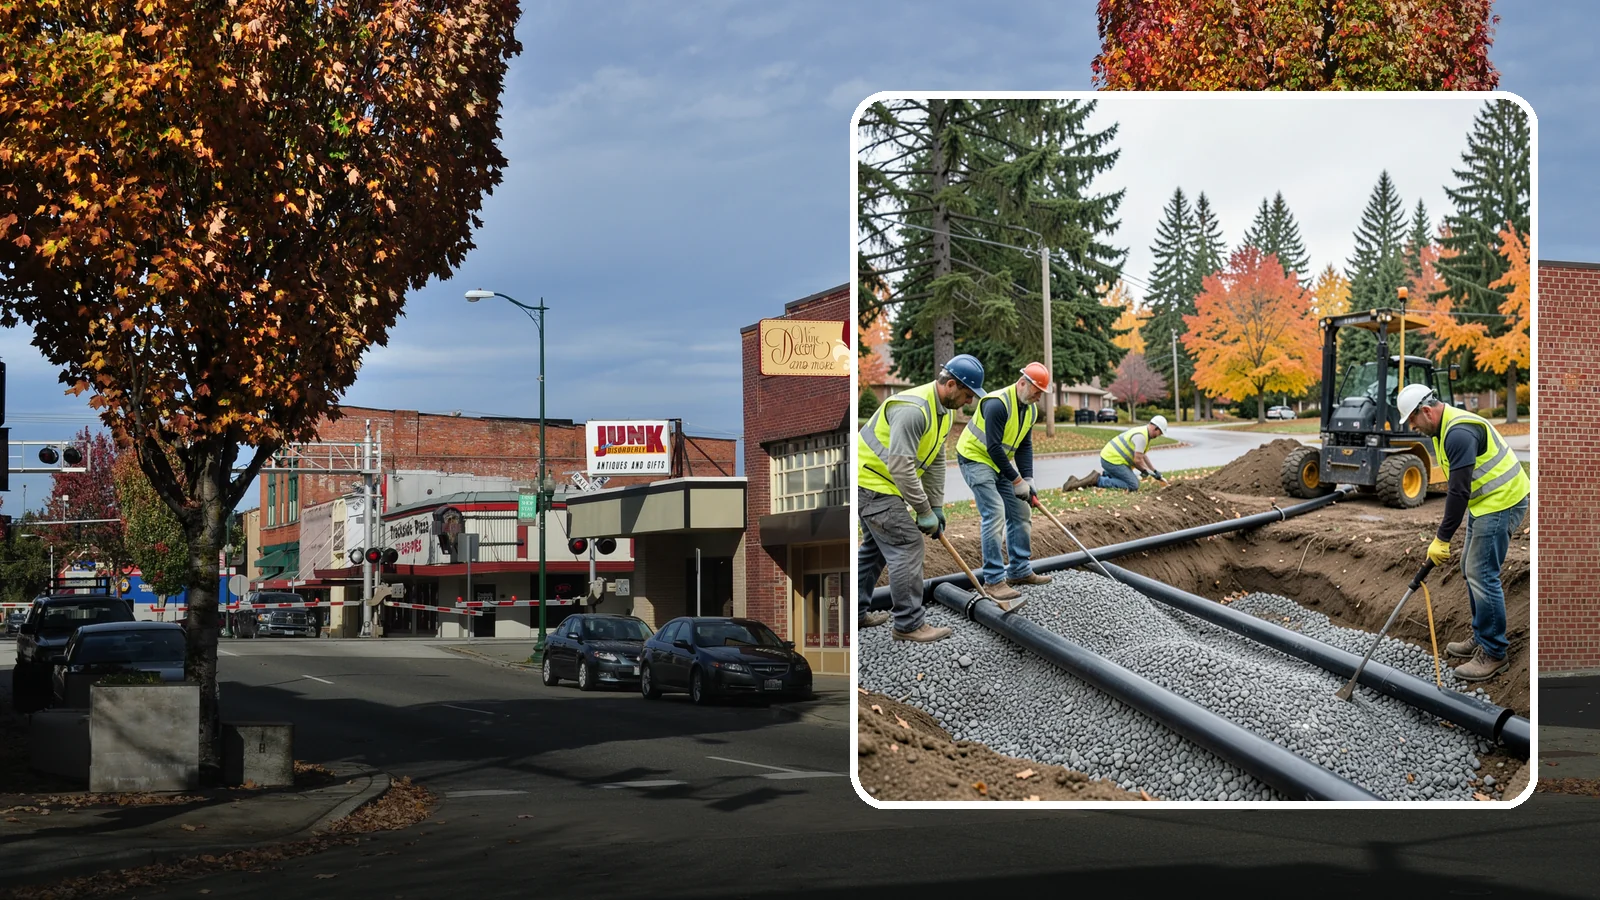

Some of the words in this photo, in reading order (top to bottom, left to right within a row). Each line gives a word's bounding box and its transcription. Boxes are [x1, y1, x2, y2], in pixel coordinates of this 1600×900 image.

[595, 425, 665, 457] JUNK
[607, 446, 645, 454] DISORDERLY
[597, 461, 628, 470] ANTIQUES
[631, 461, 644, 470] AND
[647, 460, 665, 470] GIFTS
[390, 521, 413, 539] Trackside
[414, 520, 429, 535] Pizza
